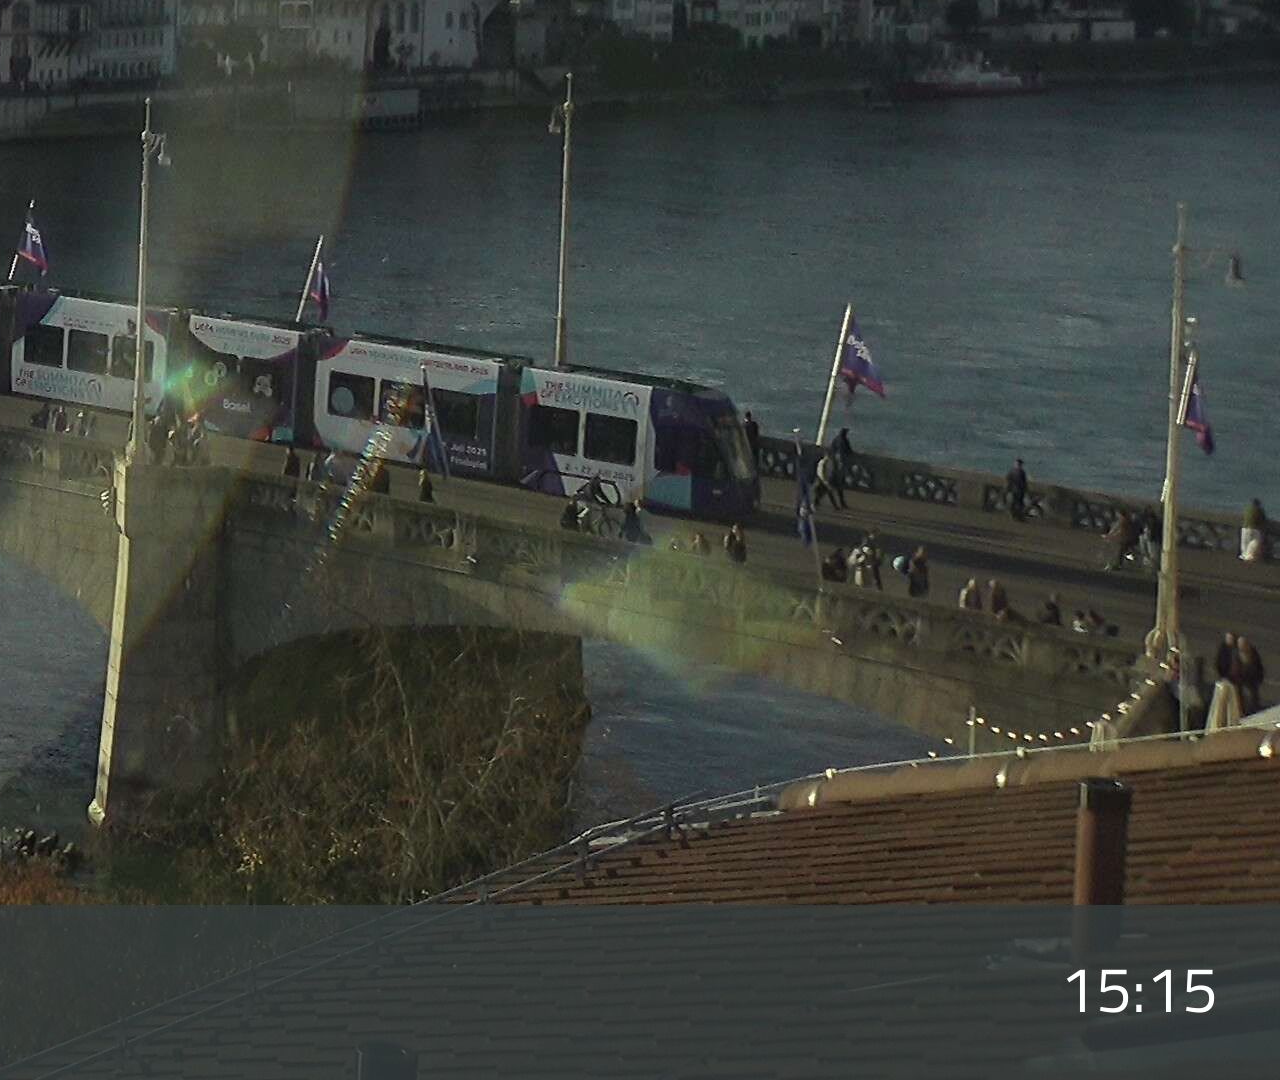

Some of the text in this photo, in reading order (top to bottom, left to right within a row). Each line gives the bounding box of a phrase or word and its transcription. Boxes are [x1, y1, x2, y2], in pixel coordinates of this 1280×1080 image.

[545, 380, 564, 393] THE
[223, 398, 252, 412] Basel
[465, 445, 487, 457] 2025
[612, 471, 635, 482] 2025
